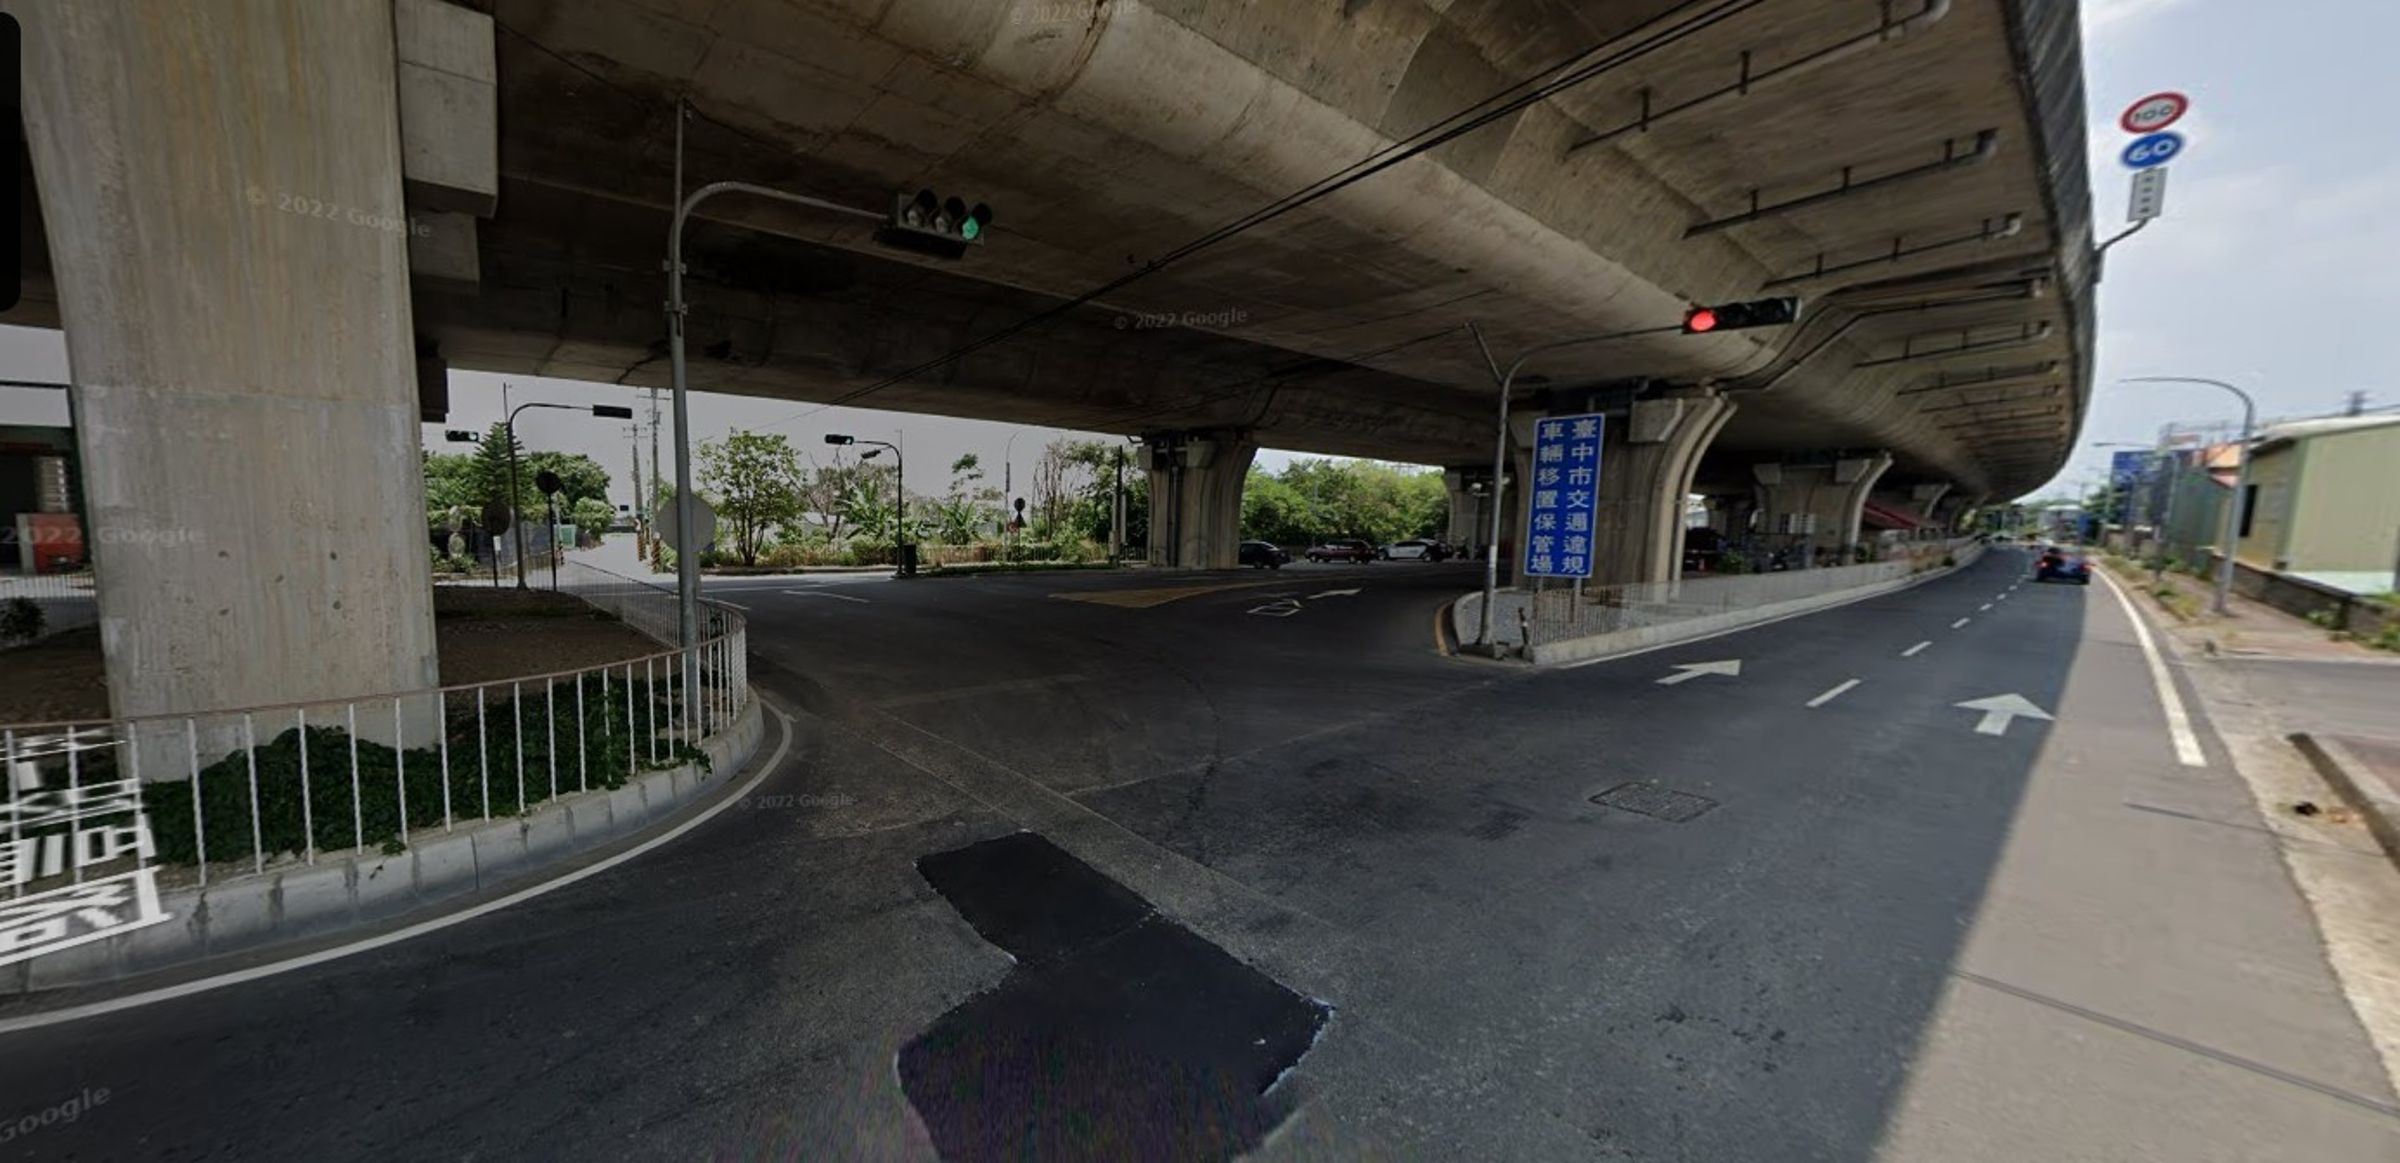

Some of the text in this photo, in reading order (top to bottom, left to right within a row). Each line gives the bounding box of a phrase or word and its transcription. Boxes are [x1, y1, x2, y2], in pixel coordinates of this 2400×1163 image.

[2127, 139, 2176, 162] 60
[2133, 102, 2174, 123] 100
[1531, 422, 1564, 572] 車輛移置保管場
[1561, 419, 1598, 574] 臺中市交通違規
